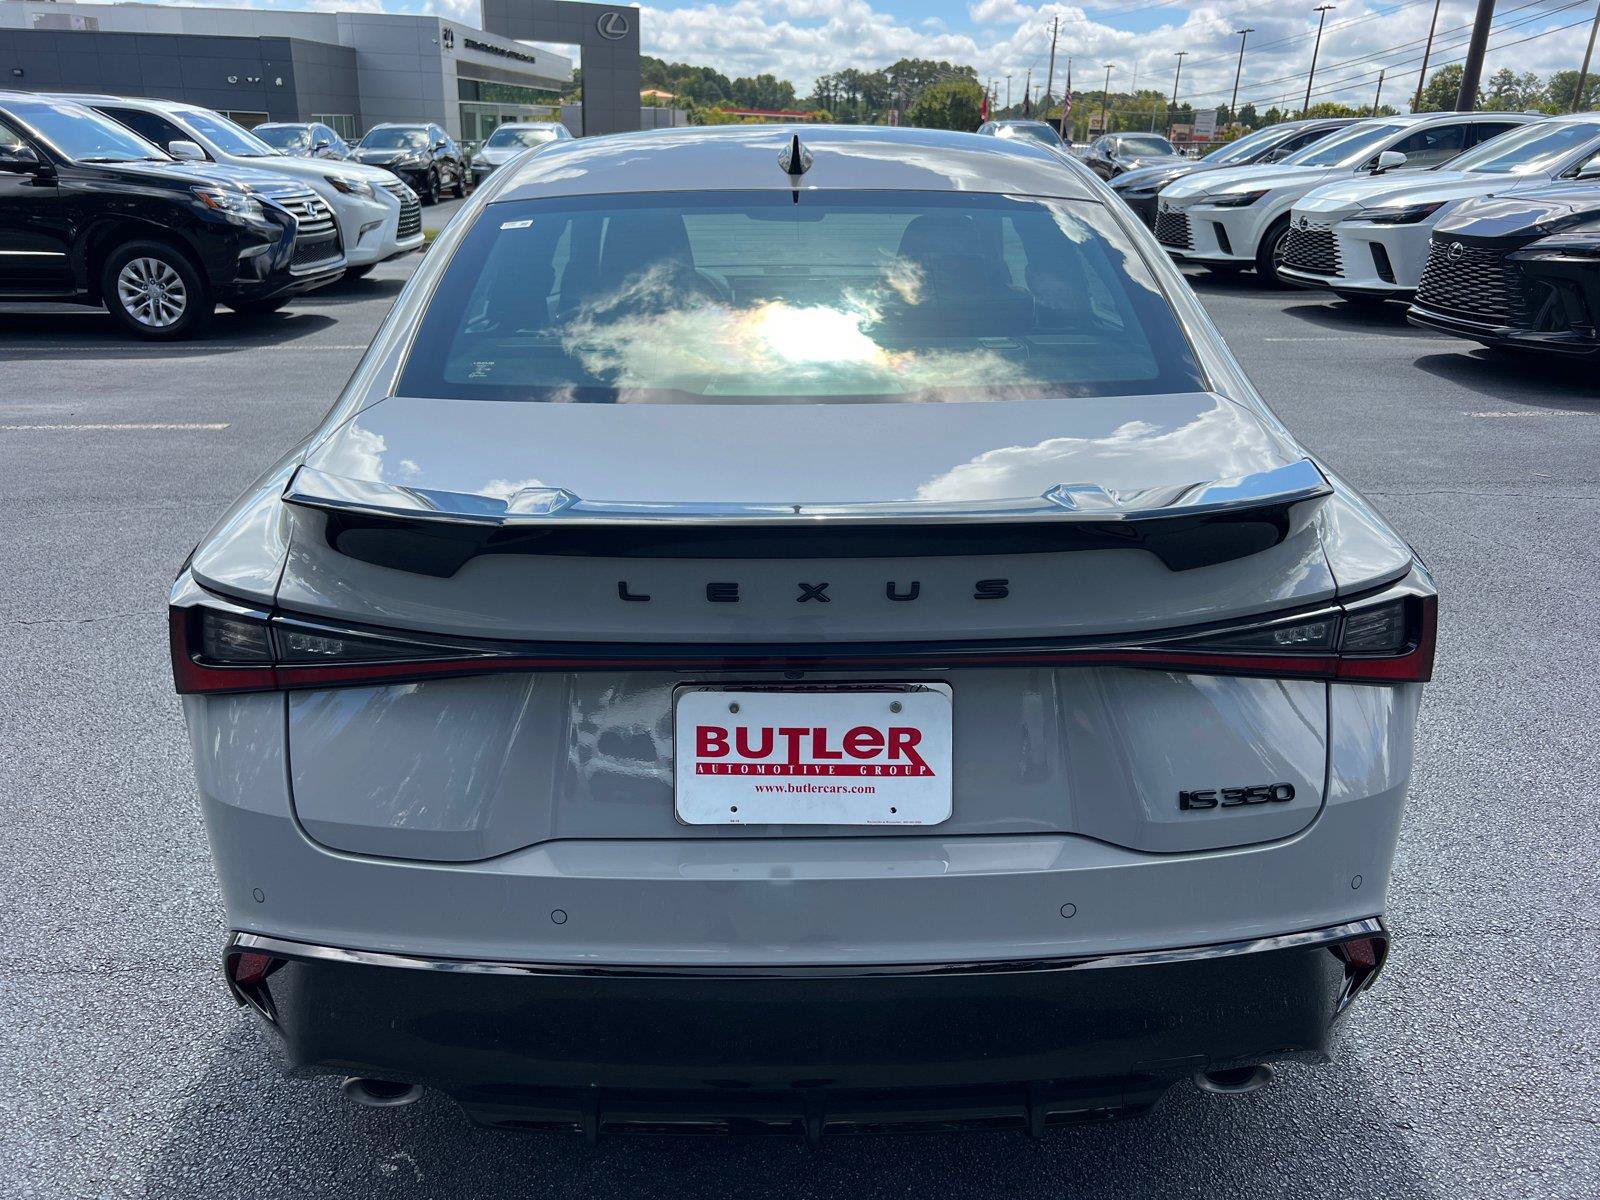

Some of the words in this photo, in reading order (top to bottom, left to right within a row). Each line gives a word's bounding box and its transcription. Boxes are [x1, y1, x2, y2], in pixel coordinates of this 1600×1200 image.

[617, 579, 1010, 603] LEXUS
[696, 764, 836, 775] AUTOMOTIVE
[859, 764, 928, 775] GROUP
[755, 783, 876, 795] www.butlercars.com
[1220, 782, 1296, 808] 350
